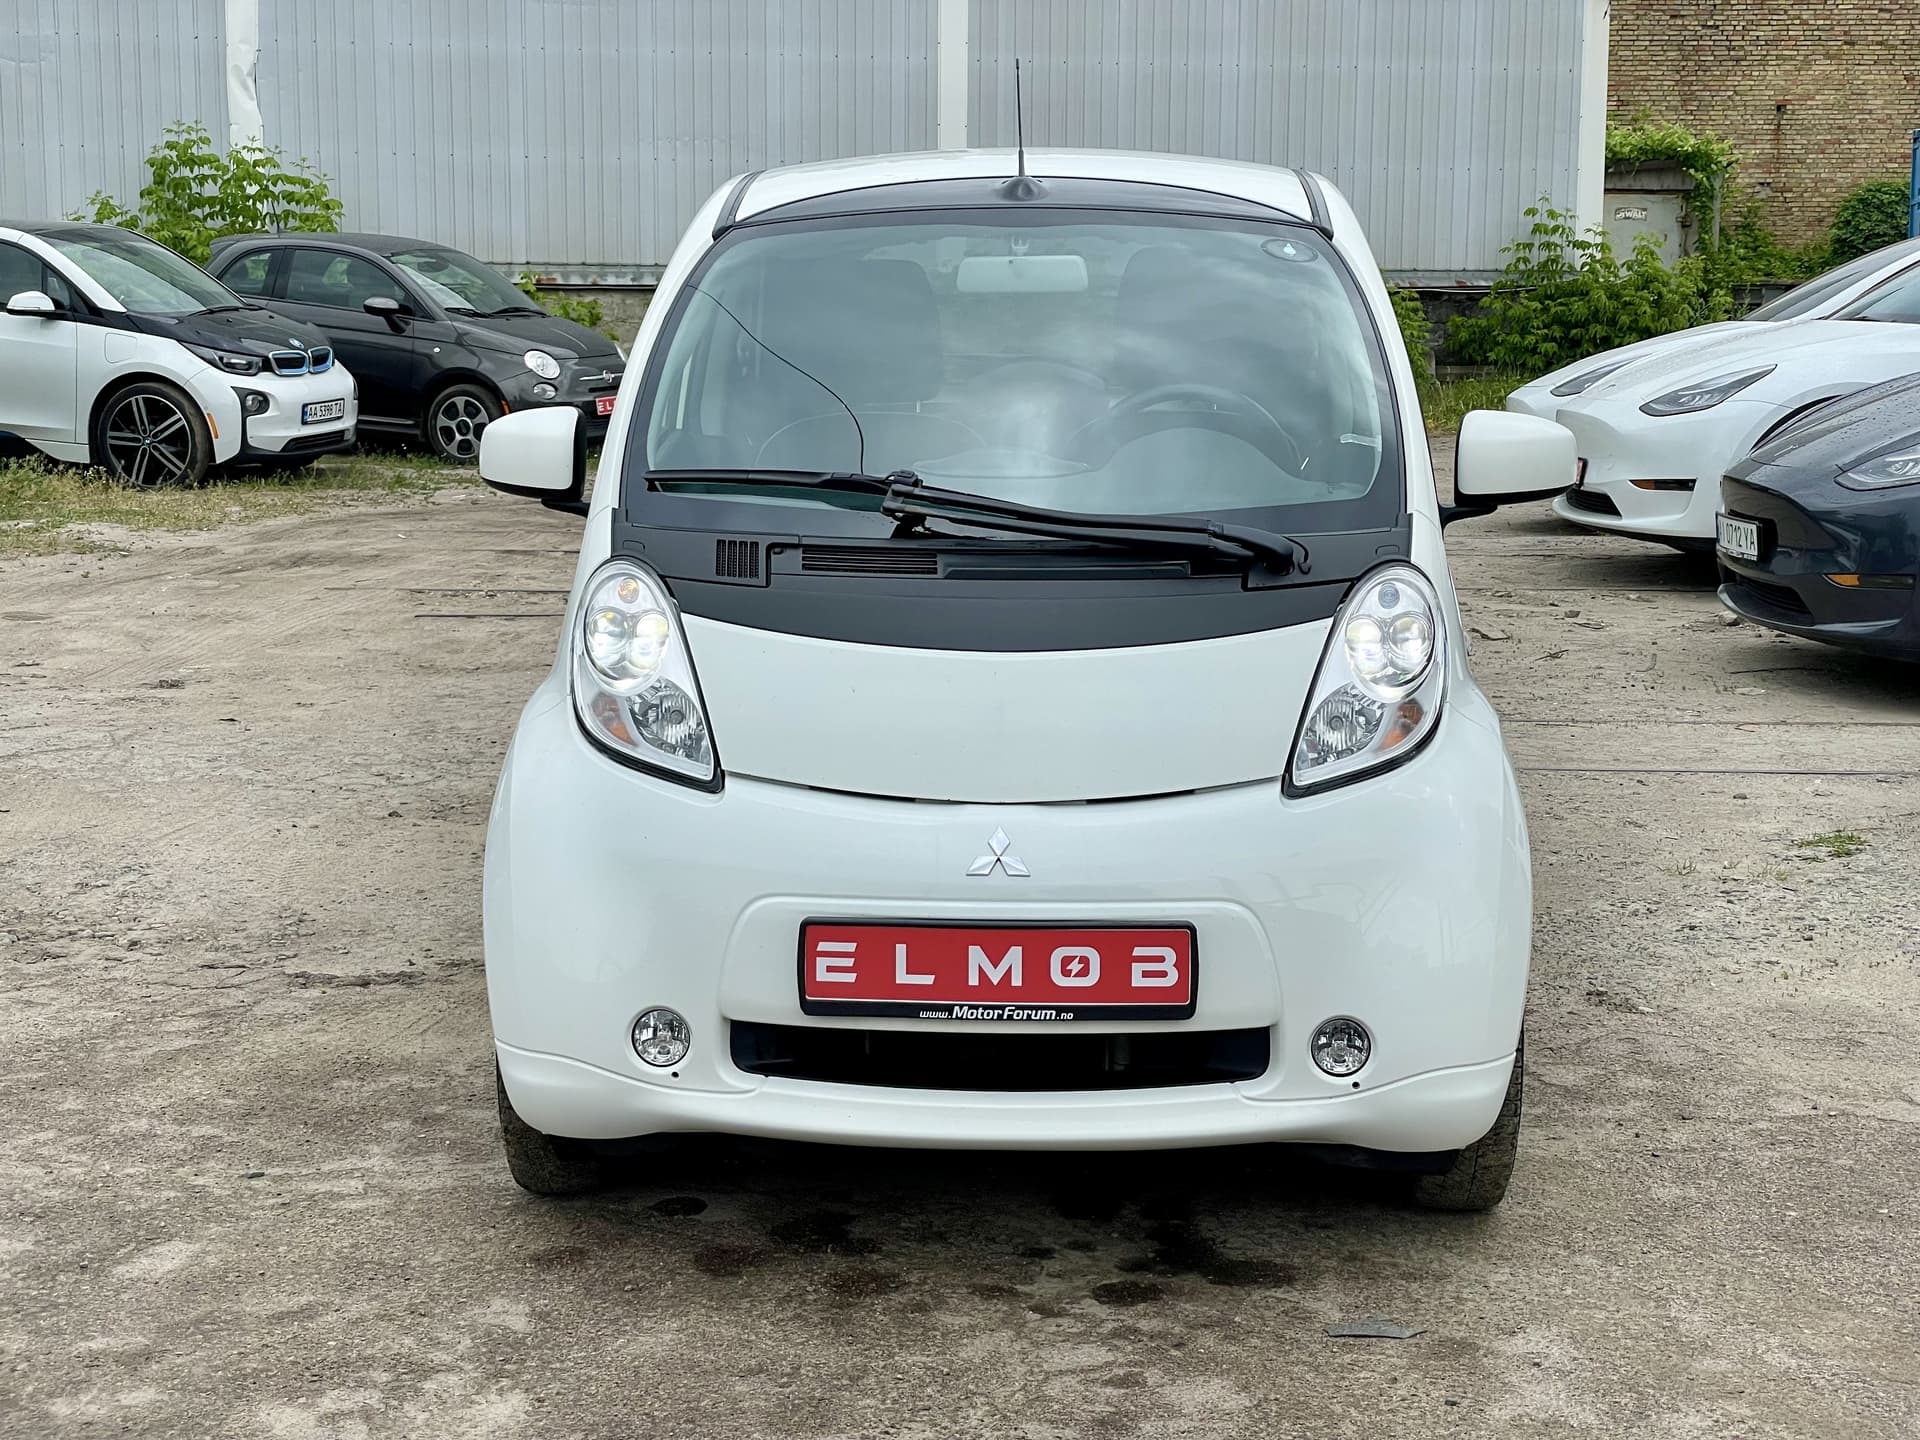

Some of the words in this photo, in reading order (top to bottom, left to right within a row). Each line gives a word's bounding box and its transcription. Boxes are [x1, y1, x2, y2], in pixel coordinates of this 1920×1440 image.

[308, 406, 318, 418] AA
[334, 402, 342, 415] TA
[1726, 522, 1743, 548] 0712
[1743, 527, 1756, 551] YA
[815, 941, 1179, 988] ELMOB
